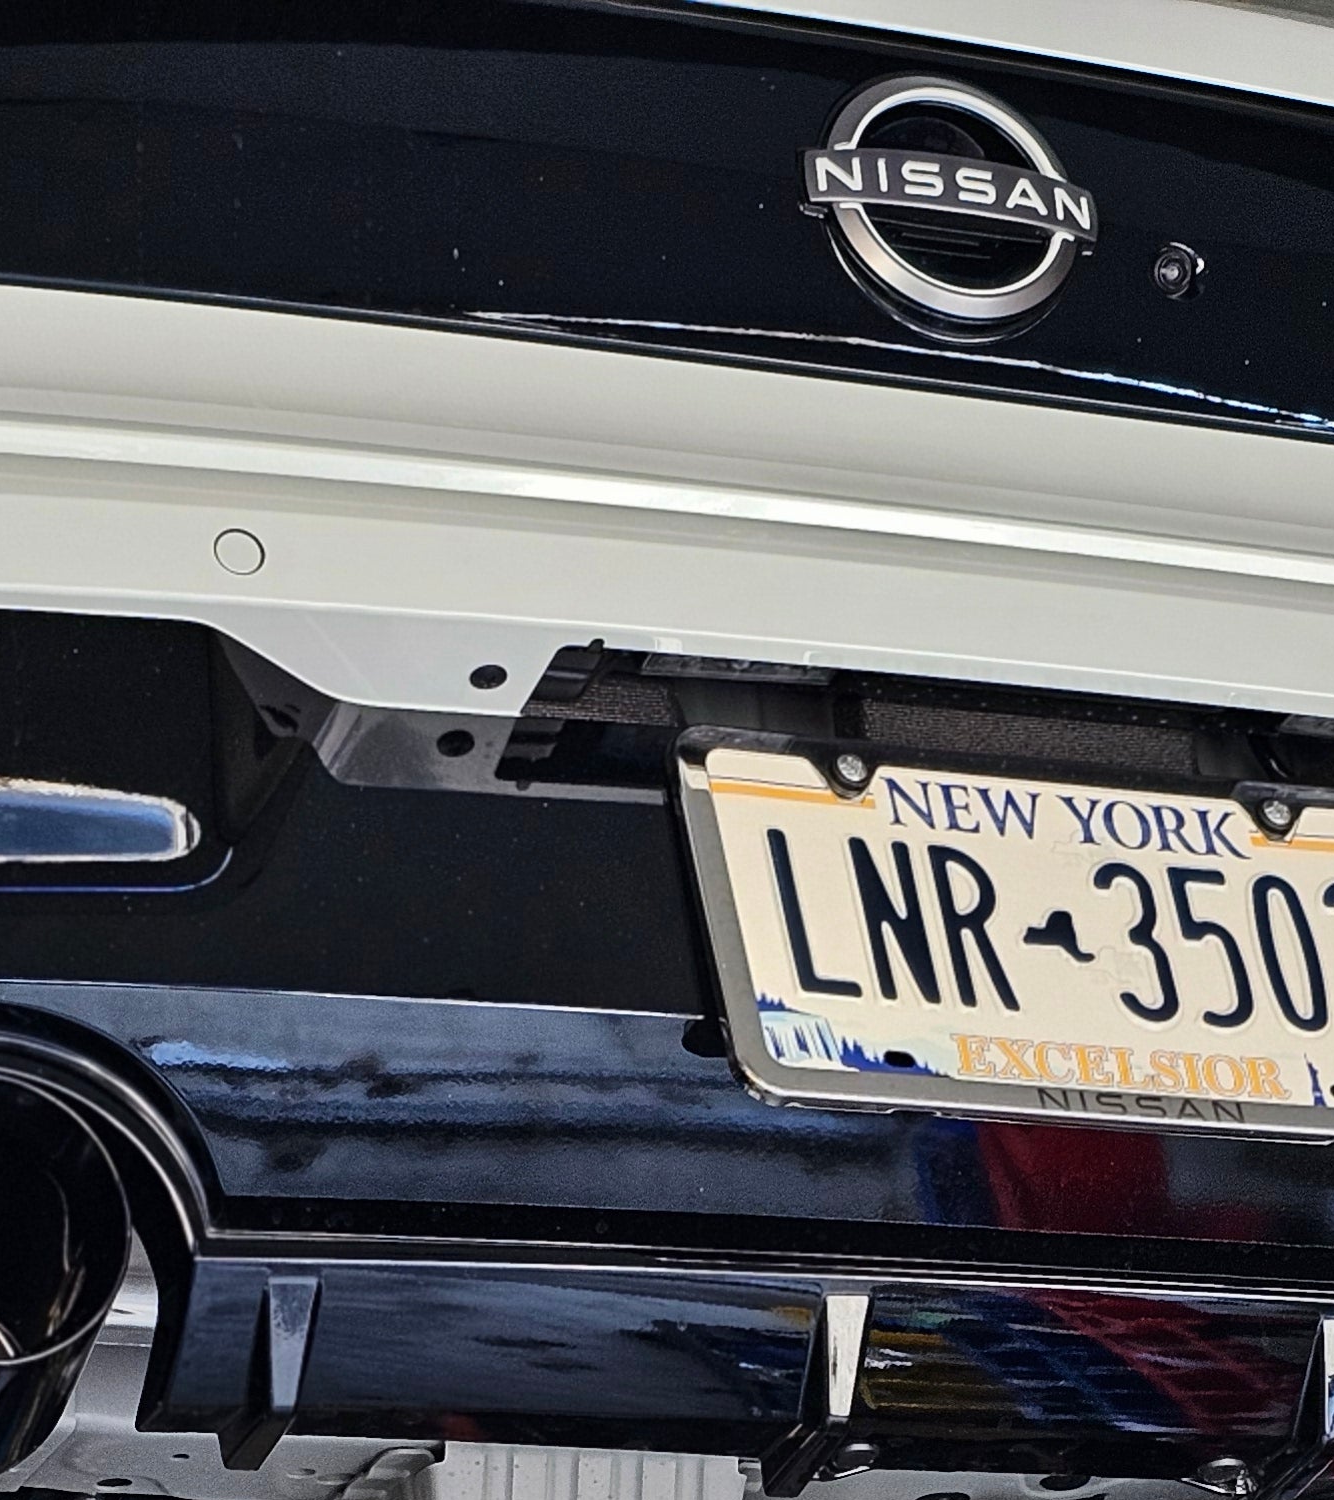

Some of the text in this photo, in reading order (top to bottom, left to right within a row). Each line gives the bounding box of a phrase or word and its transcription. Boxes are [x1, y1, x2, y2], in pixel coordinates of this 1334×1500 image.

[815, 156, 1091, 231] NISSAN
[879, 777, 1251, 860] NEW YORK
[950, 1033, 1291, 1100] EXCELSIOR
[1038, 1088, 1246, 1123] NISSAN
